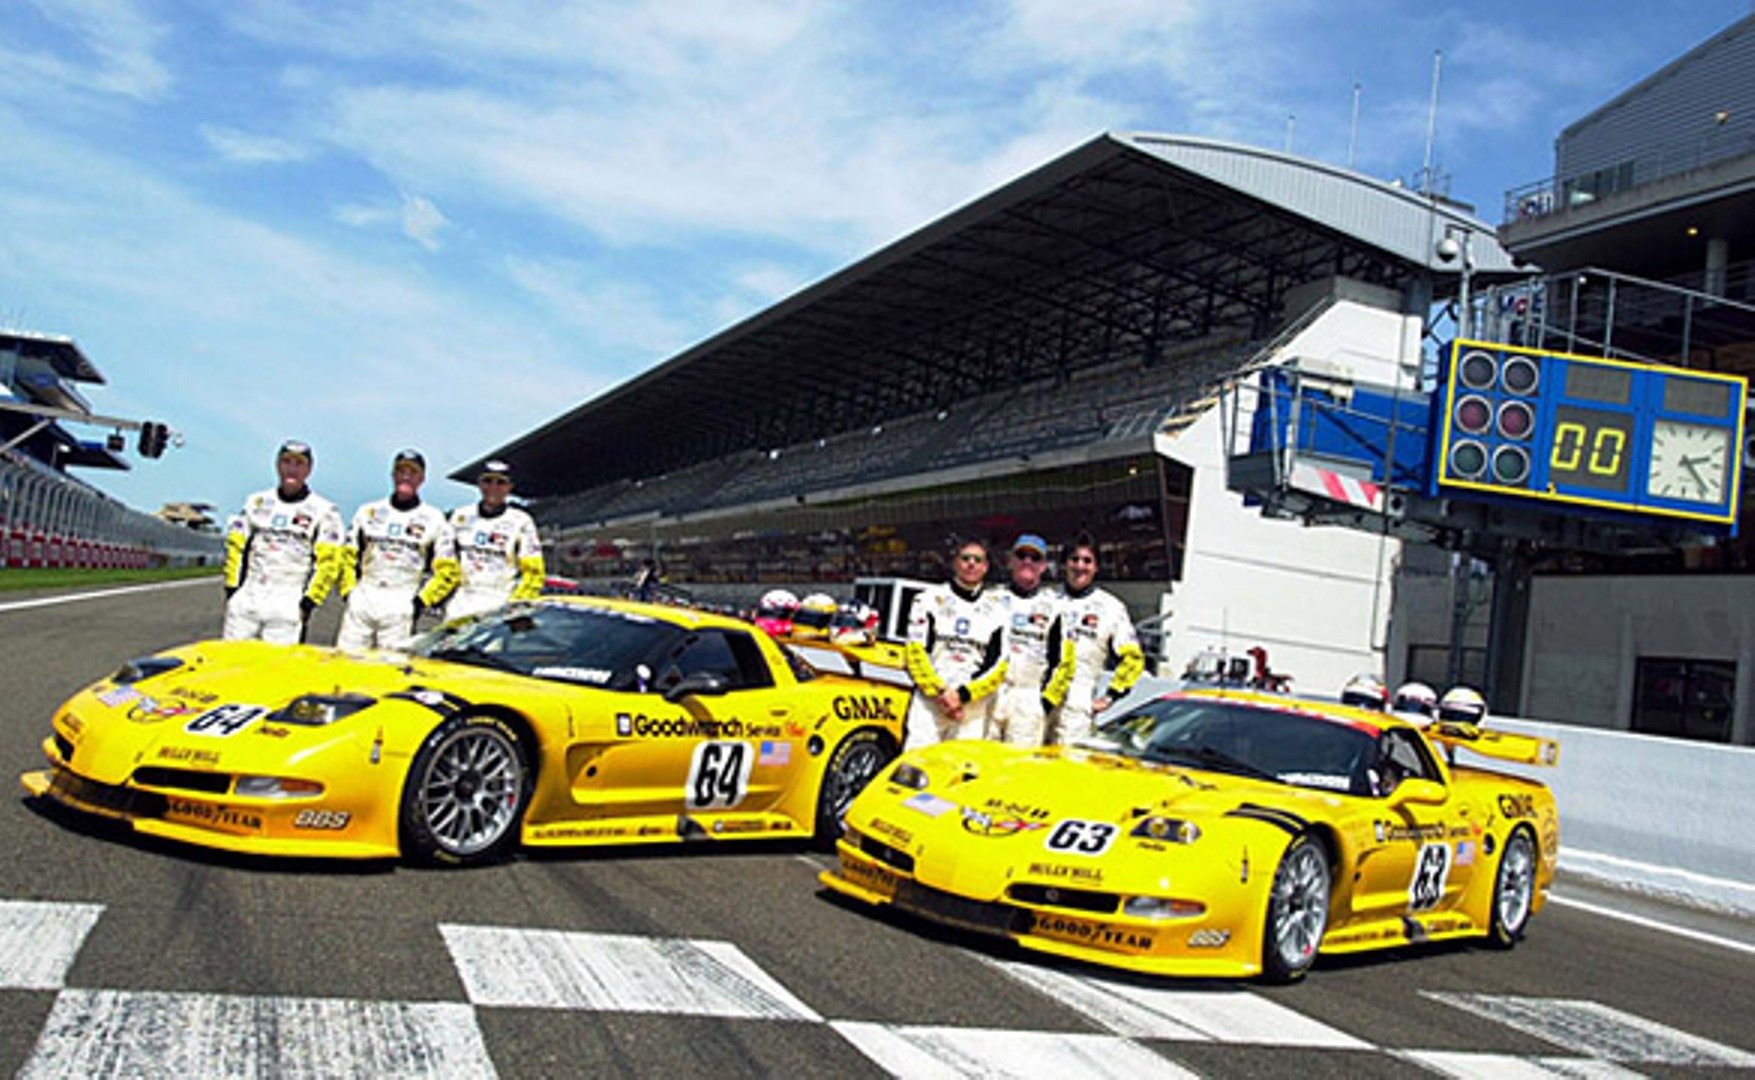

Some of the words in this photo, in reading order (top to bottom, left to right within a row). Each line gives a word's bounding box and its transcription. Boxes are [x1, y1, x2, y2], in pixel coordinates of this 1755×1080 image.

[1551, 423, 1625, 476] 00
[187, 705, 264, 735] 64
[833, 695, 896, 721] GMAC
[694, 742, 745, 806] 64
[1048, 821, 1115, 853] 63
